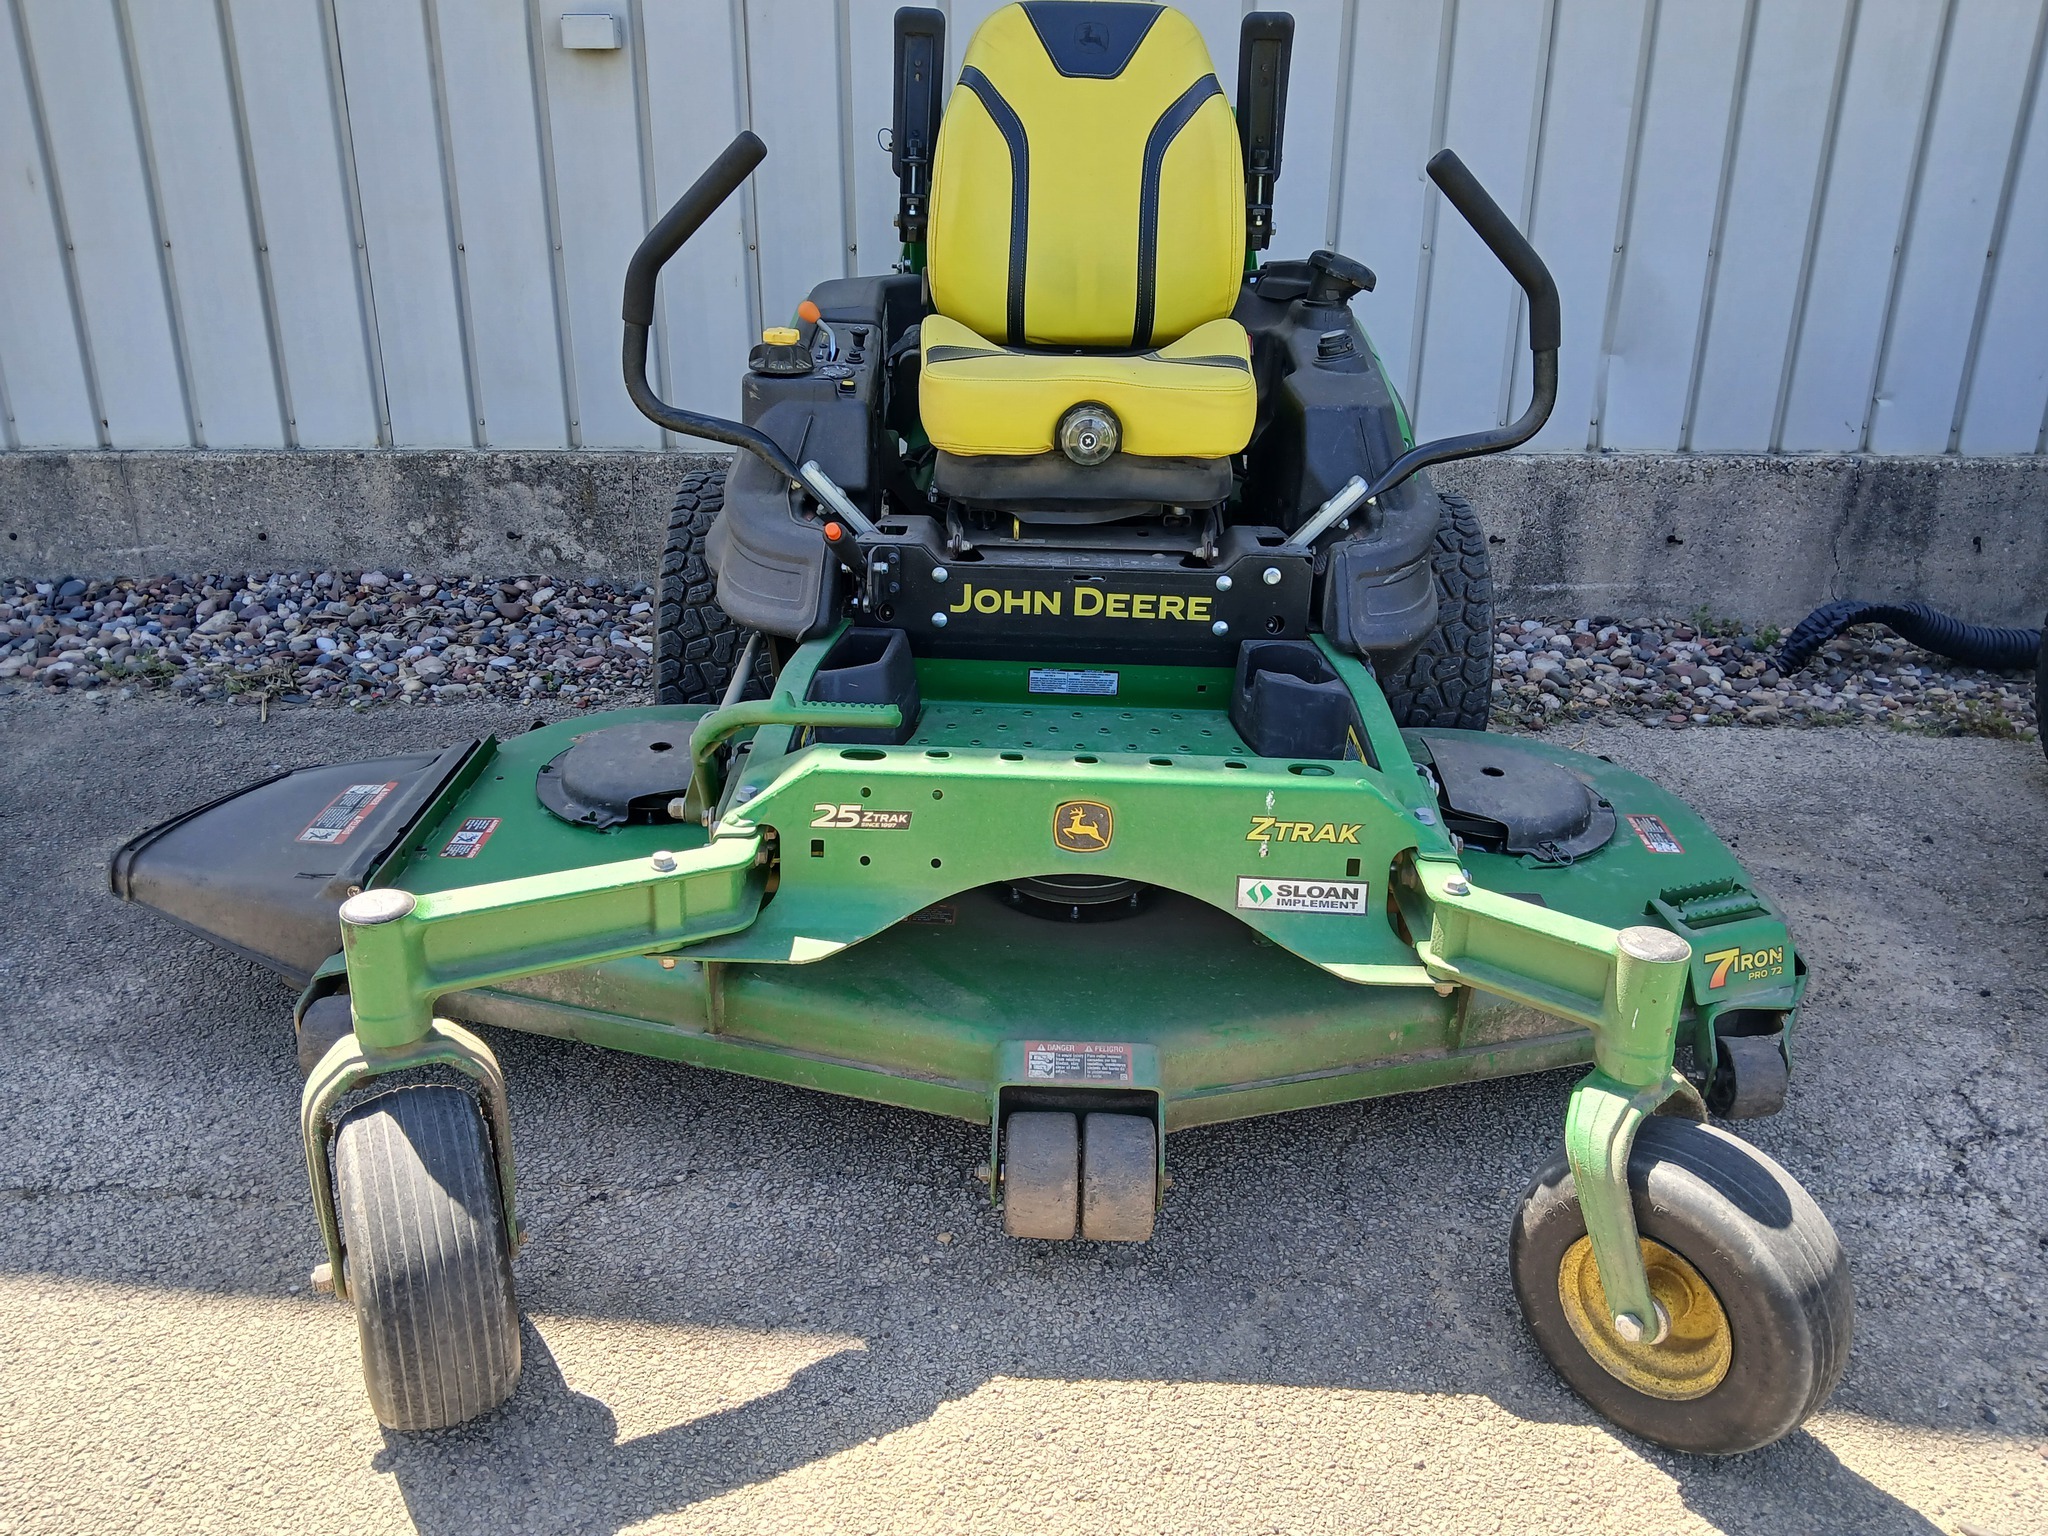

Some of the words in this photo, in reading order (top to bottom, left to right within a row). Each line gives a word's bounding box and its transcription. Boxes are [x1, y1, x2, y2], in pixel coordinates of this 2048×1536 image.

[950, 583, 1062, 616] JOHN
[1073, 586, 1213, 621] DEERE
[810, 804, 862, 828] 25
[862, 811, 908, 823] ZTRAK
[1246, 816, 1364, 844] ZTRAK
[1276, 884, 1359, 900] SLOAN
[1276, 898, 1359, 910] IMPLEMENT
[1748, 969, 1768, 980] PRO
[1770, 966, 1783, 976] 72
[1047, 1044, 1075, 1052] DANGER
[1094, 1045, 1124, 1053] PELIGRO
